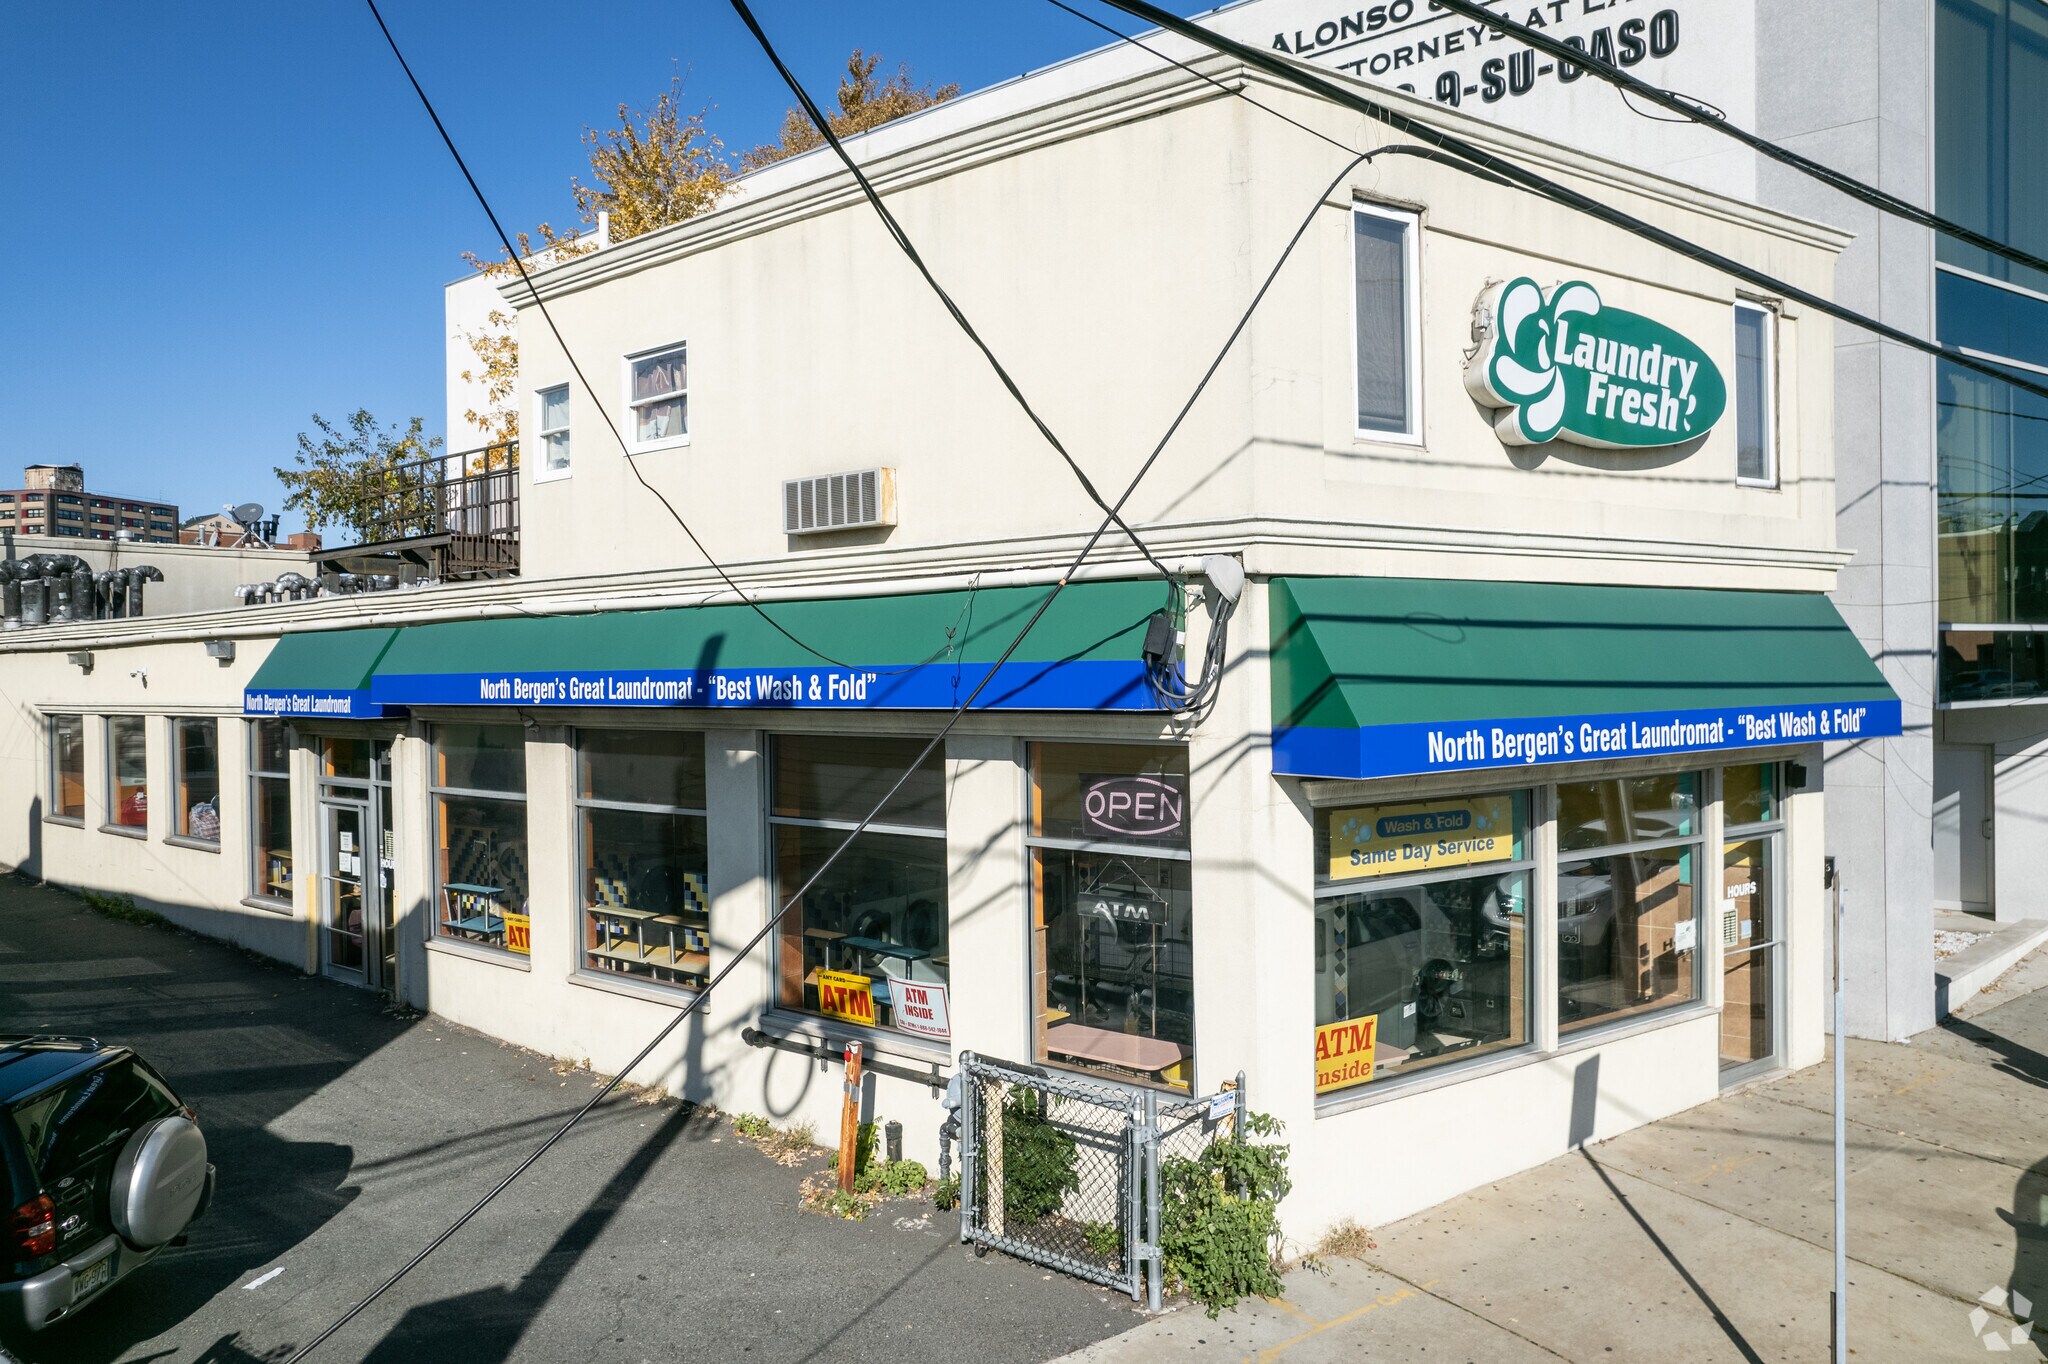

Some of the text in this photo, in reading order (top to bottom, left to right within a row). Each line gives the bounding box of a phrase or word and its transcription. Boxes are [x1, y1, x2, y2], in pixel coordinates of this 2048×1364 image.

[1272, 0, 1414, 54] ALONSO
[1526, 0, 1570, 28] AT
[1554, 319, 1698, 400] Laundry
[1586, 371, 1682, 432] Fresh
[480, 677, 511, 700] North
[514, 676, 566, 704] Bergen’s
[569, 677, 605, 700] Great
[608, 676, 693, 701] Laundromat
[708, 674, 751, 701] “Best
[756, 673, 802, 701] Wash
[808, 673, 822, 701] &
[828, 671, 877, 700] Fold”
[246, 693, 351, 716] North Bergen’s Great Laundromat
[1428, 729, 1485, 763] North
[1491, 725, 1574, 764] Bergen’s
[1580, 722, 1627, 753] Great
[1631, 717, 1724, 750] Laundromat
[1738, 713, 1776, 741] “Best
[1779, 709, 1816, 738] Wash
[1820, 709, 1830, 734] &
[1834, 707, 1866, 734] Fold”
[1085, 790, 1182, 822] OPEN
[1384, 814, 1464, 834] Wash & Fold
[1350, 838, 1494, 866] Same Day Service
[1727, 881, 1757, 898] HOURS
[1092, 899, 1150, 920] ATM
[823, 984, 872, 1018] ATM
[905, 987, 929, 1006] ATM
[904, 1004, 934, 1020] INSIDE
[1315, 1021, 1374, 1061] ATM
